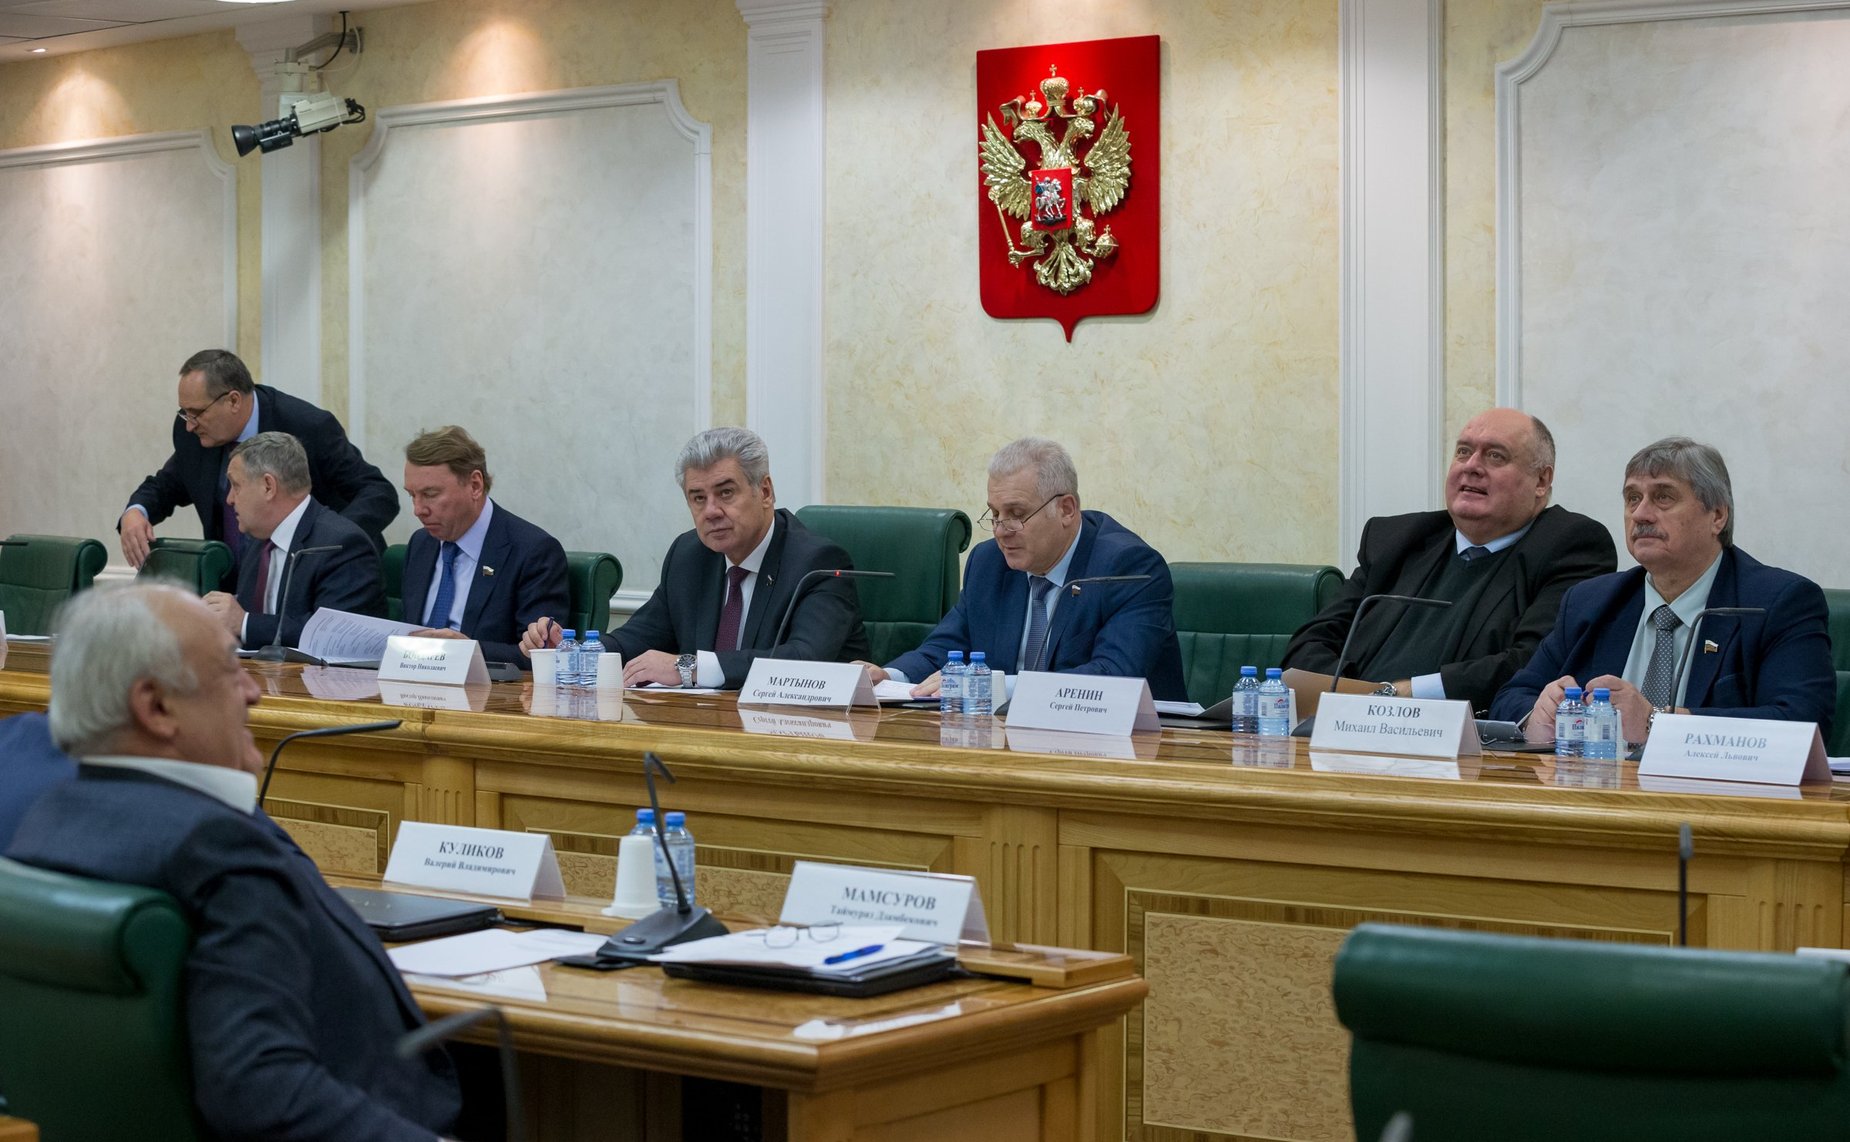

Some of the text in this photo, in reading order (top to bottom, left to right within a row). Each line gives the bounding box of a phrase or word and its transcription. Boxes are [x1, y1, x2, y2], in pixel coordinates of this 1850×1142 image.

[400, 662, 417, 671] Виктор
[767, 676, 826, 690] МАРТЫНОВ
[753, 689, 832, 703] Сергей Александрович
[1055, 688, 1104, 701] АРЕНИН
[1050, 702, 1107, 714] Сергей Петрович
[1367, 704, 1421, 719] КОЗЛОВ
[1334, 720, 1443, 738] Михаил Васильевич
[1684, 733, 1767, 749] РАХМАНОВ
[1684, 750, 1759, 762] Алексей Львович
[439, 841, 504, 860] КУЛИКОВ
[424, 858, 516, 875] Валерий Владимирович
[841, 886, 936, 911] МАМСУРОВ
